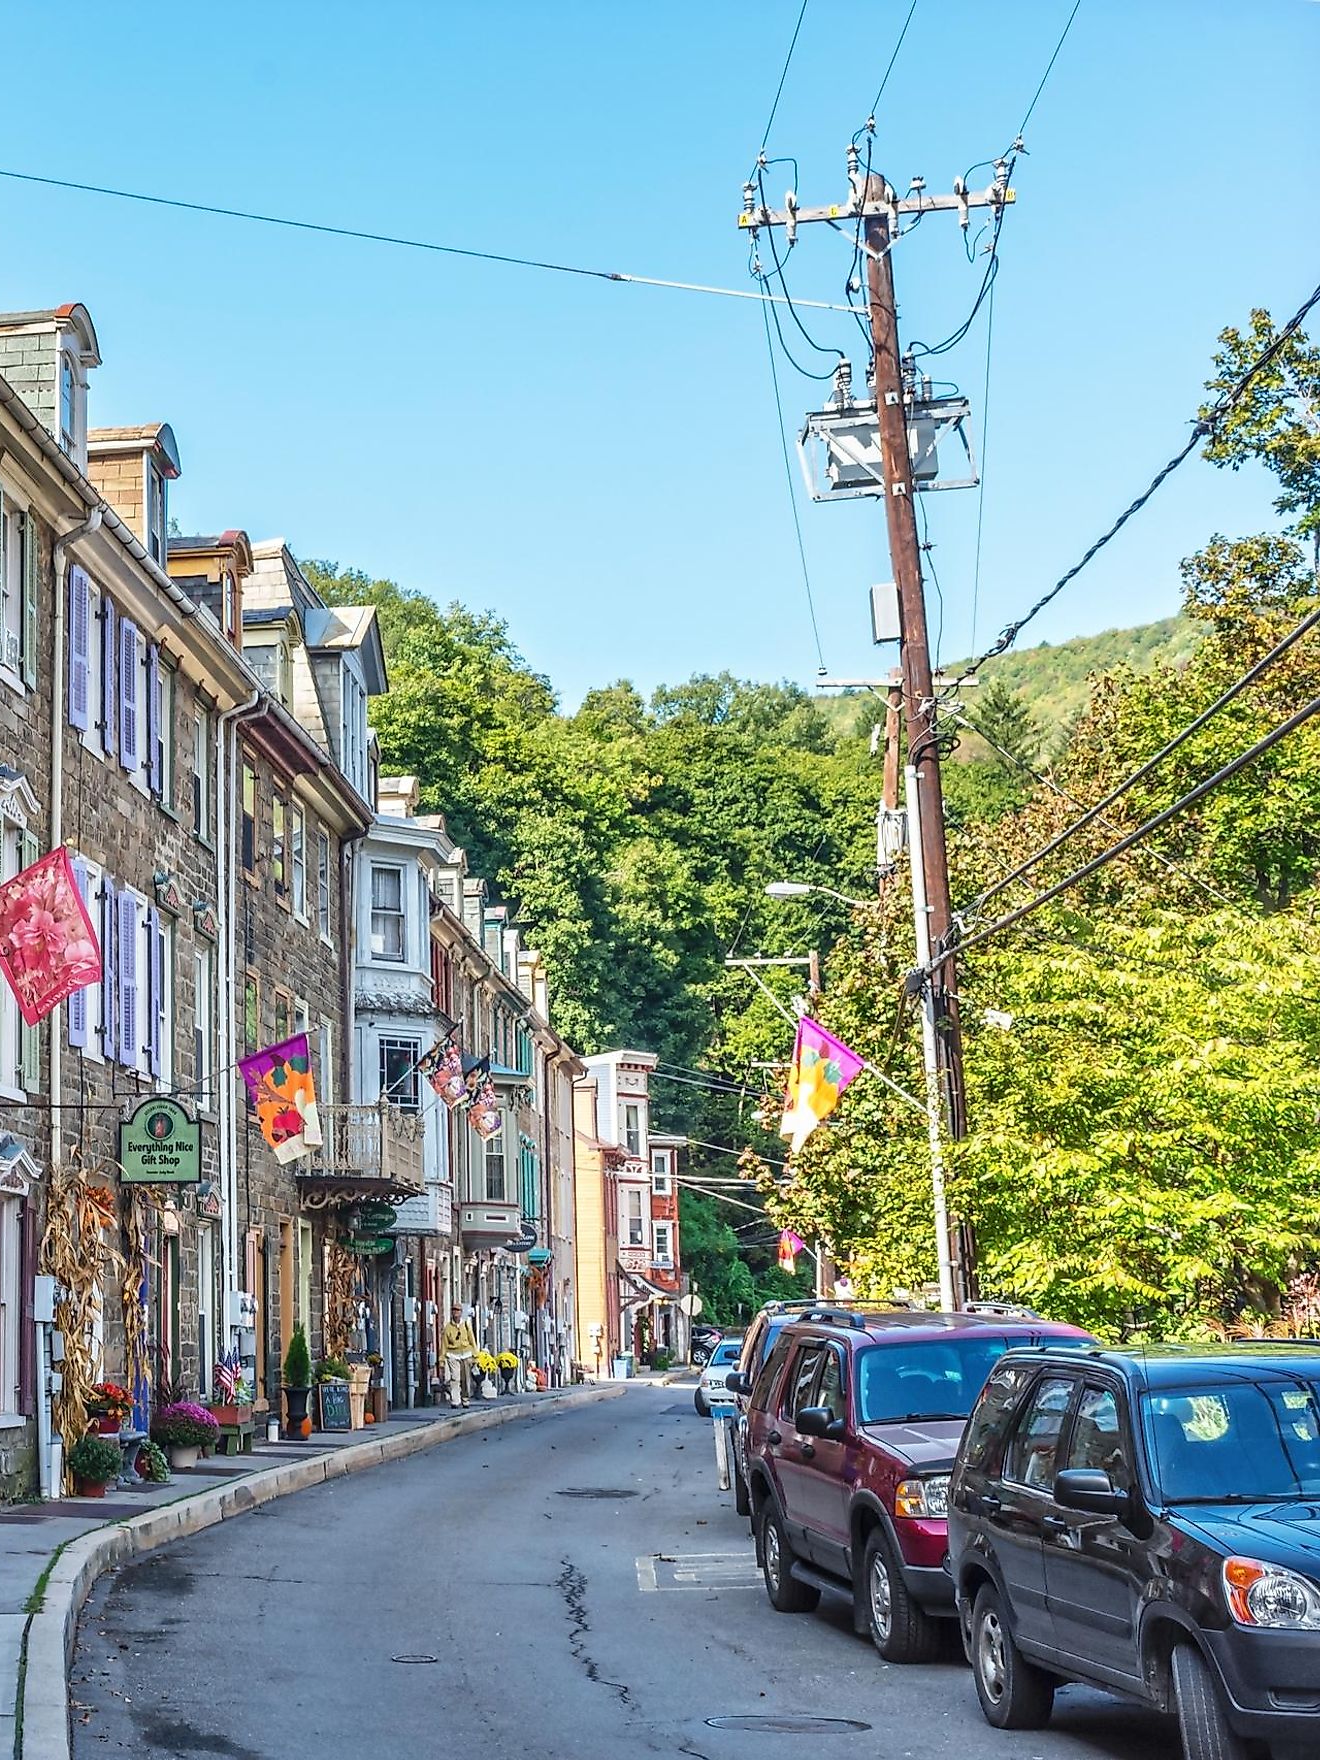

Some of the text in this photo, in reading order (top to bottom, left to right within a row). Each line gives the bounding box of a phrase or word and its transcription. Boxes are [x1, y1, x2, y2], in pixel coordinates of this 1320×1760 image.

[128, 1141, 193, 1154] Everything Nice
[141, 1154, 180, 1167] Gift Shop
